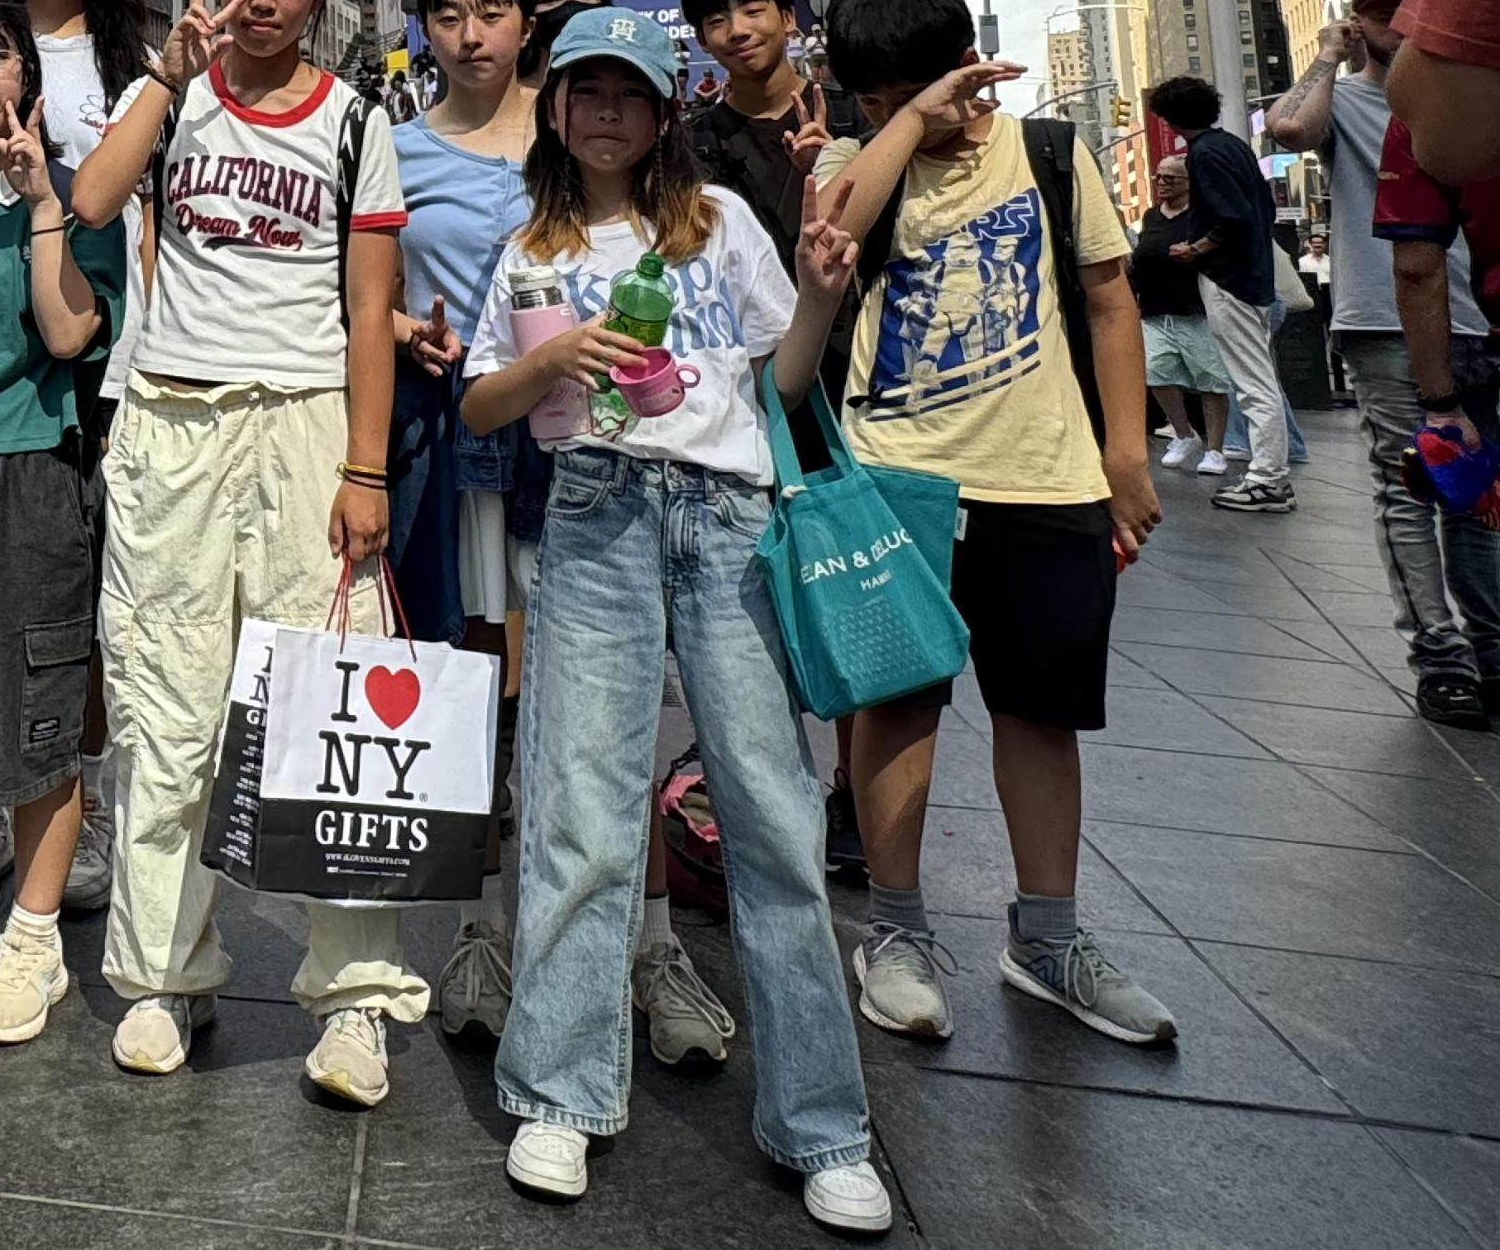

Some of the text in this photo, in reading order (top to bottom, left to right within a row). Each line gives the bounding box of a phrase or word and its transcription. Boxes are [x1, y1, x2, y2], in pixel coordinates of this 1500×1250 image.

[657, 8, 680, 23] OF
[167, 153, 324, 228] CALIFORNIA
[175, 203, 303, 251] Dream Now
[851, 550, 869, 568] &
[330, 660, 360, 723] I
[316, 730, 431, 801] NY
[314, 810, 429, 852] GIFTS
